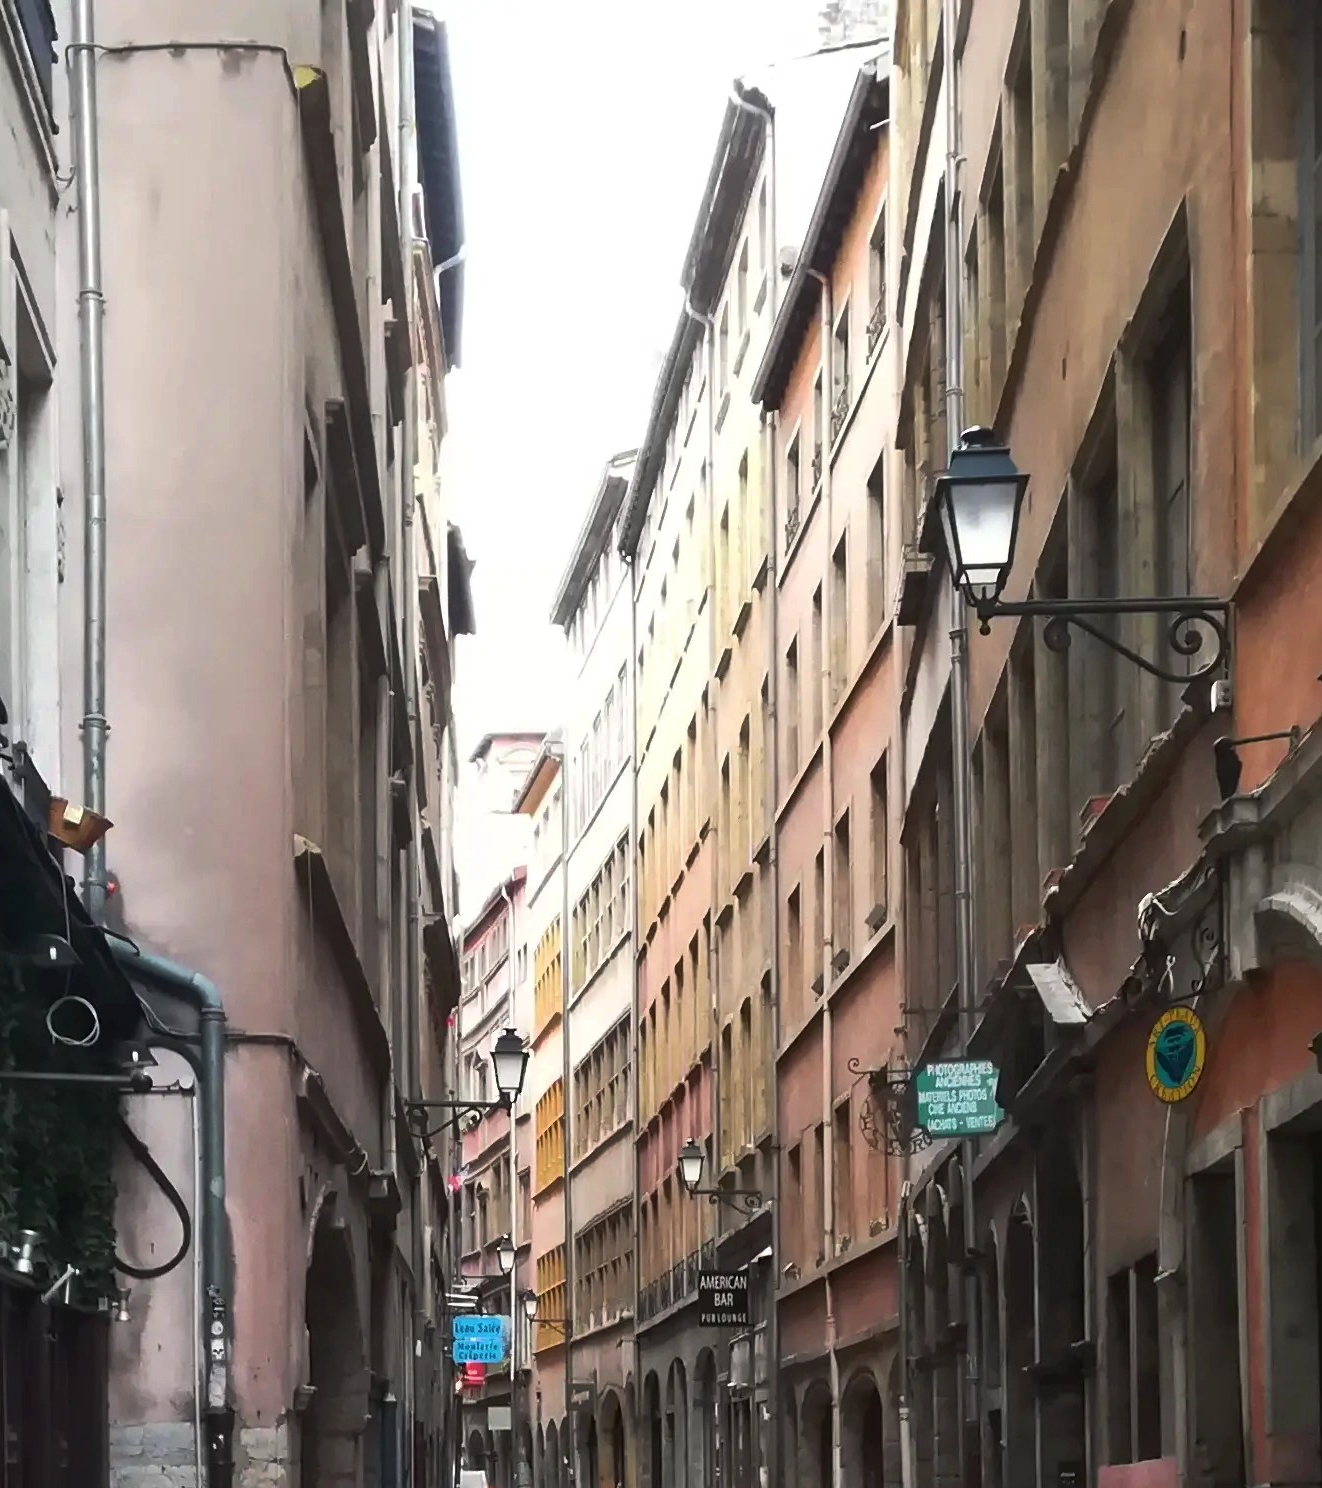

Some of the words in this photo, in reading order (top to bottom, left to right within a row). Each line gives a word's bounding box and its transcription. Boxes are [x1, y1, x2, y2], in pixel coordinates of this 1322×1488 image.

[927, 1062, 993, 1077] PHOTOGRAPHIES
[935, 1074, 982, 1088] ANCIENNES
[958, 1087, 988, 1102] PHOTOS
[946, 1101, 978, 1115] ANCIENS
[700, 1275, 746, 1290] AMERICAN
[714, 1292, 734, 1307] BAR
